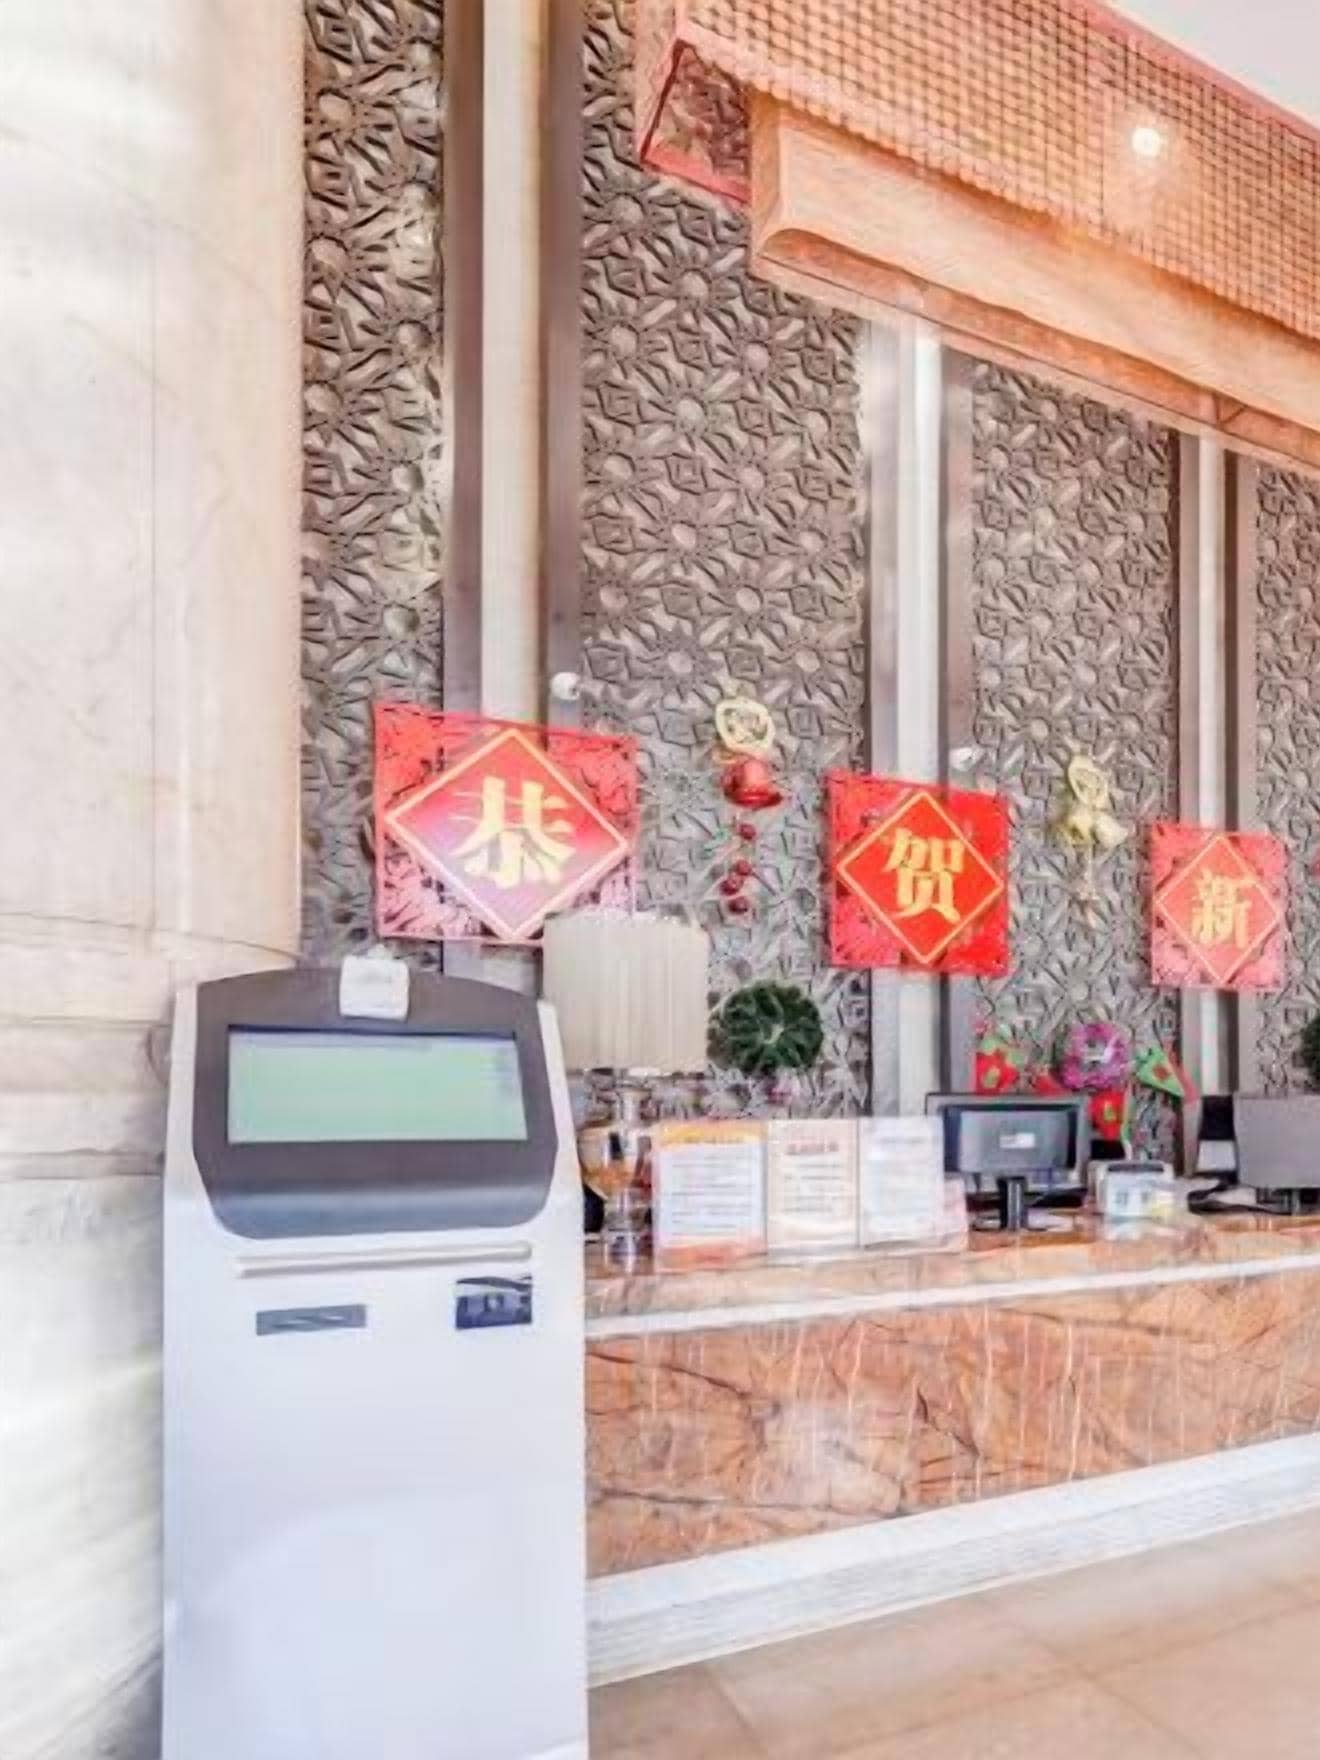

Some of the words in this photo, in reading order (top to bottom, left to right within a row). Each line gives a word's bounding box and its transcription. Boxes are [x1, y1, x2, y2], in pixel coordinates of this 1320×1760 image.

[450, 776, 576, 889] 恭
[881, 828, 962, 923] 贺
[1191, 867, 1256, 949] 新
